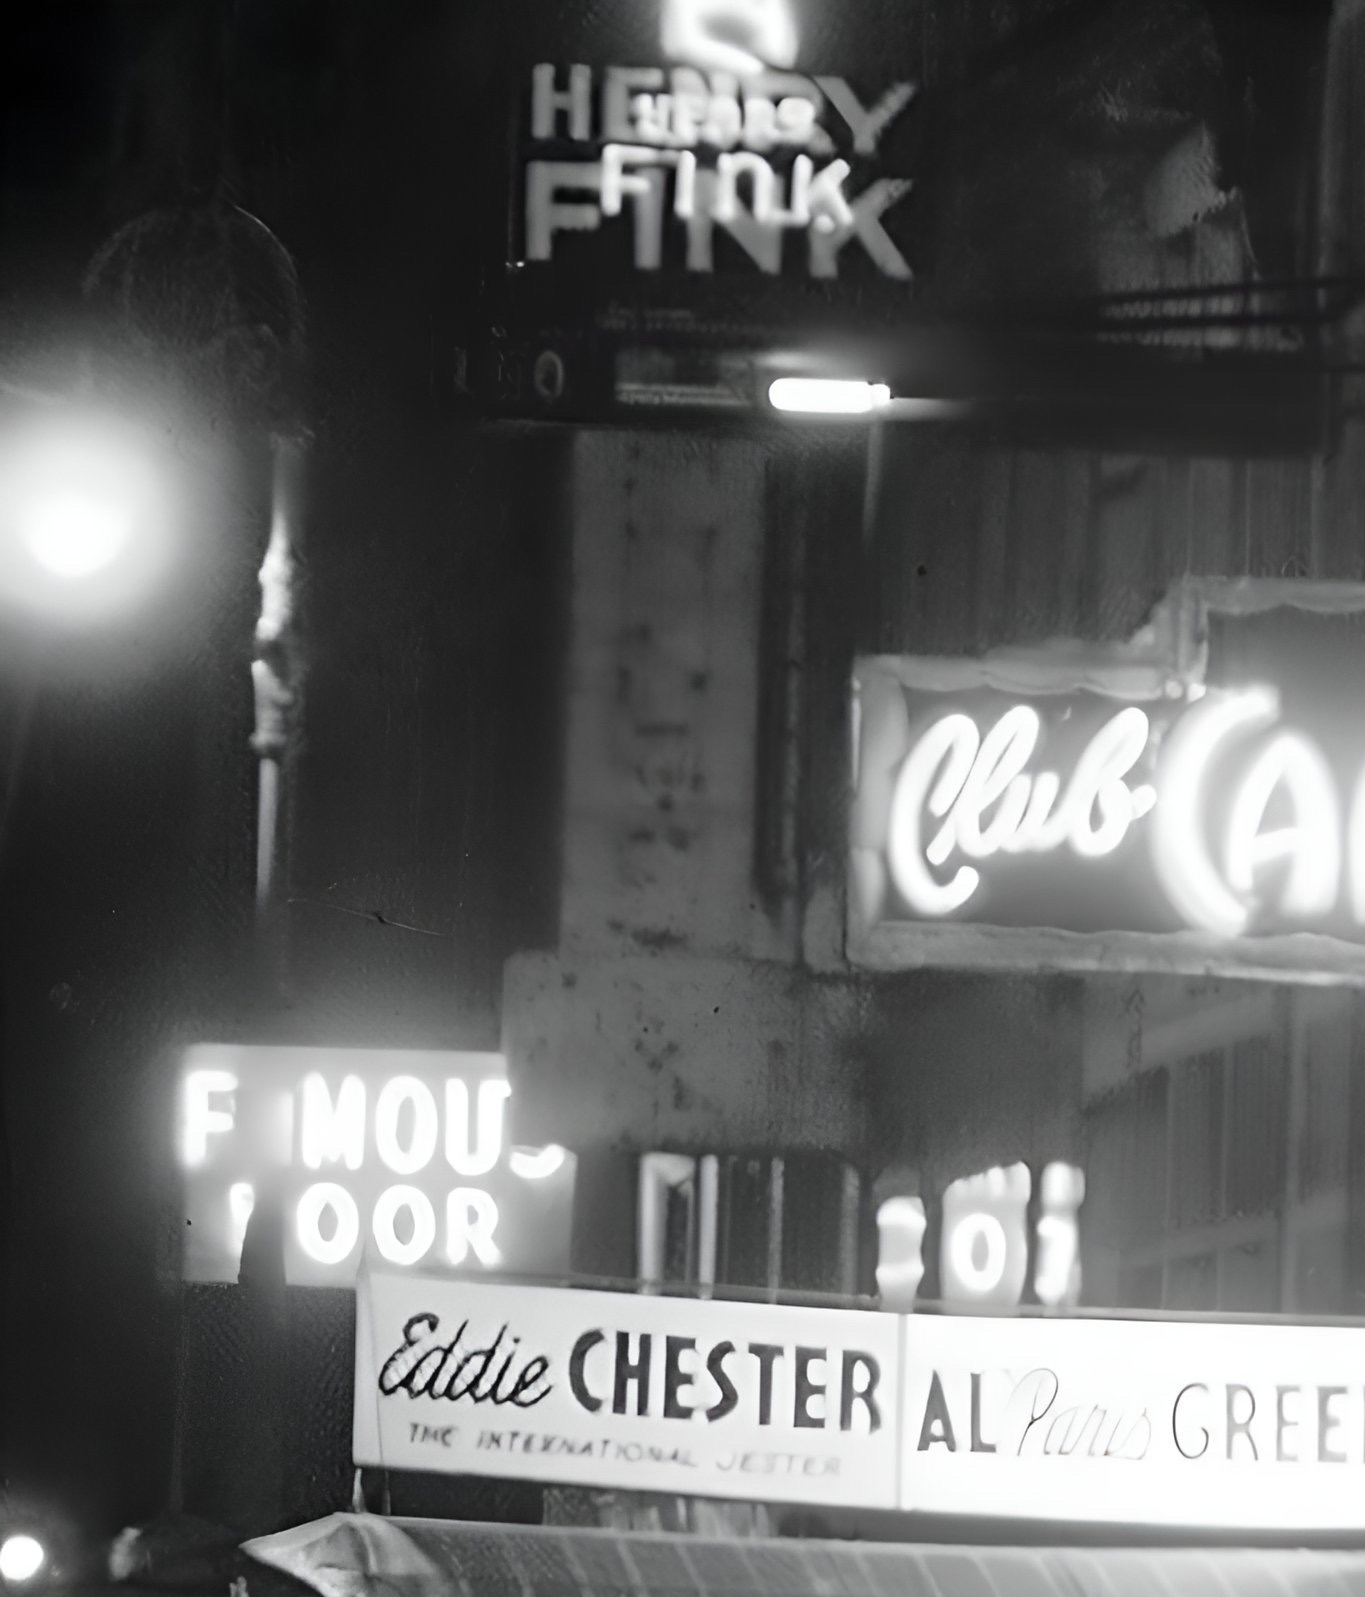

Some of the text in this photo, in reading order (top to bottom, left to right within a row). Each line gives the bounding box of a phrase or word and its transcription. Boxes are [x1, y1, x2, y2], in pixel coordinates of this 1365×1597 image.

[532, 63, 917, 156] HENRY
[526, 161, 915, 279] FINK
[890, 705, 1156, 916] Club
[182, 1069, 564, 1180] FMOU
[229, 1181, 502, 1267] OOR
[378, 1311, 882, 1434] Eddie CHESTER
[917, 1369, 998, 1453] AL
[1006, 1367, 1153, 1461] Paris
[475, 1430, 700, 1469] INTERNATIONAL
[715, 1453, 842, 1478] JESTER
